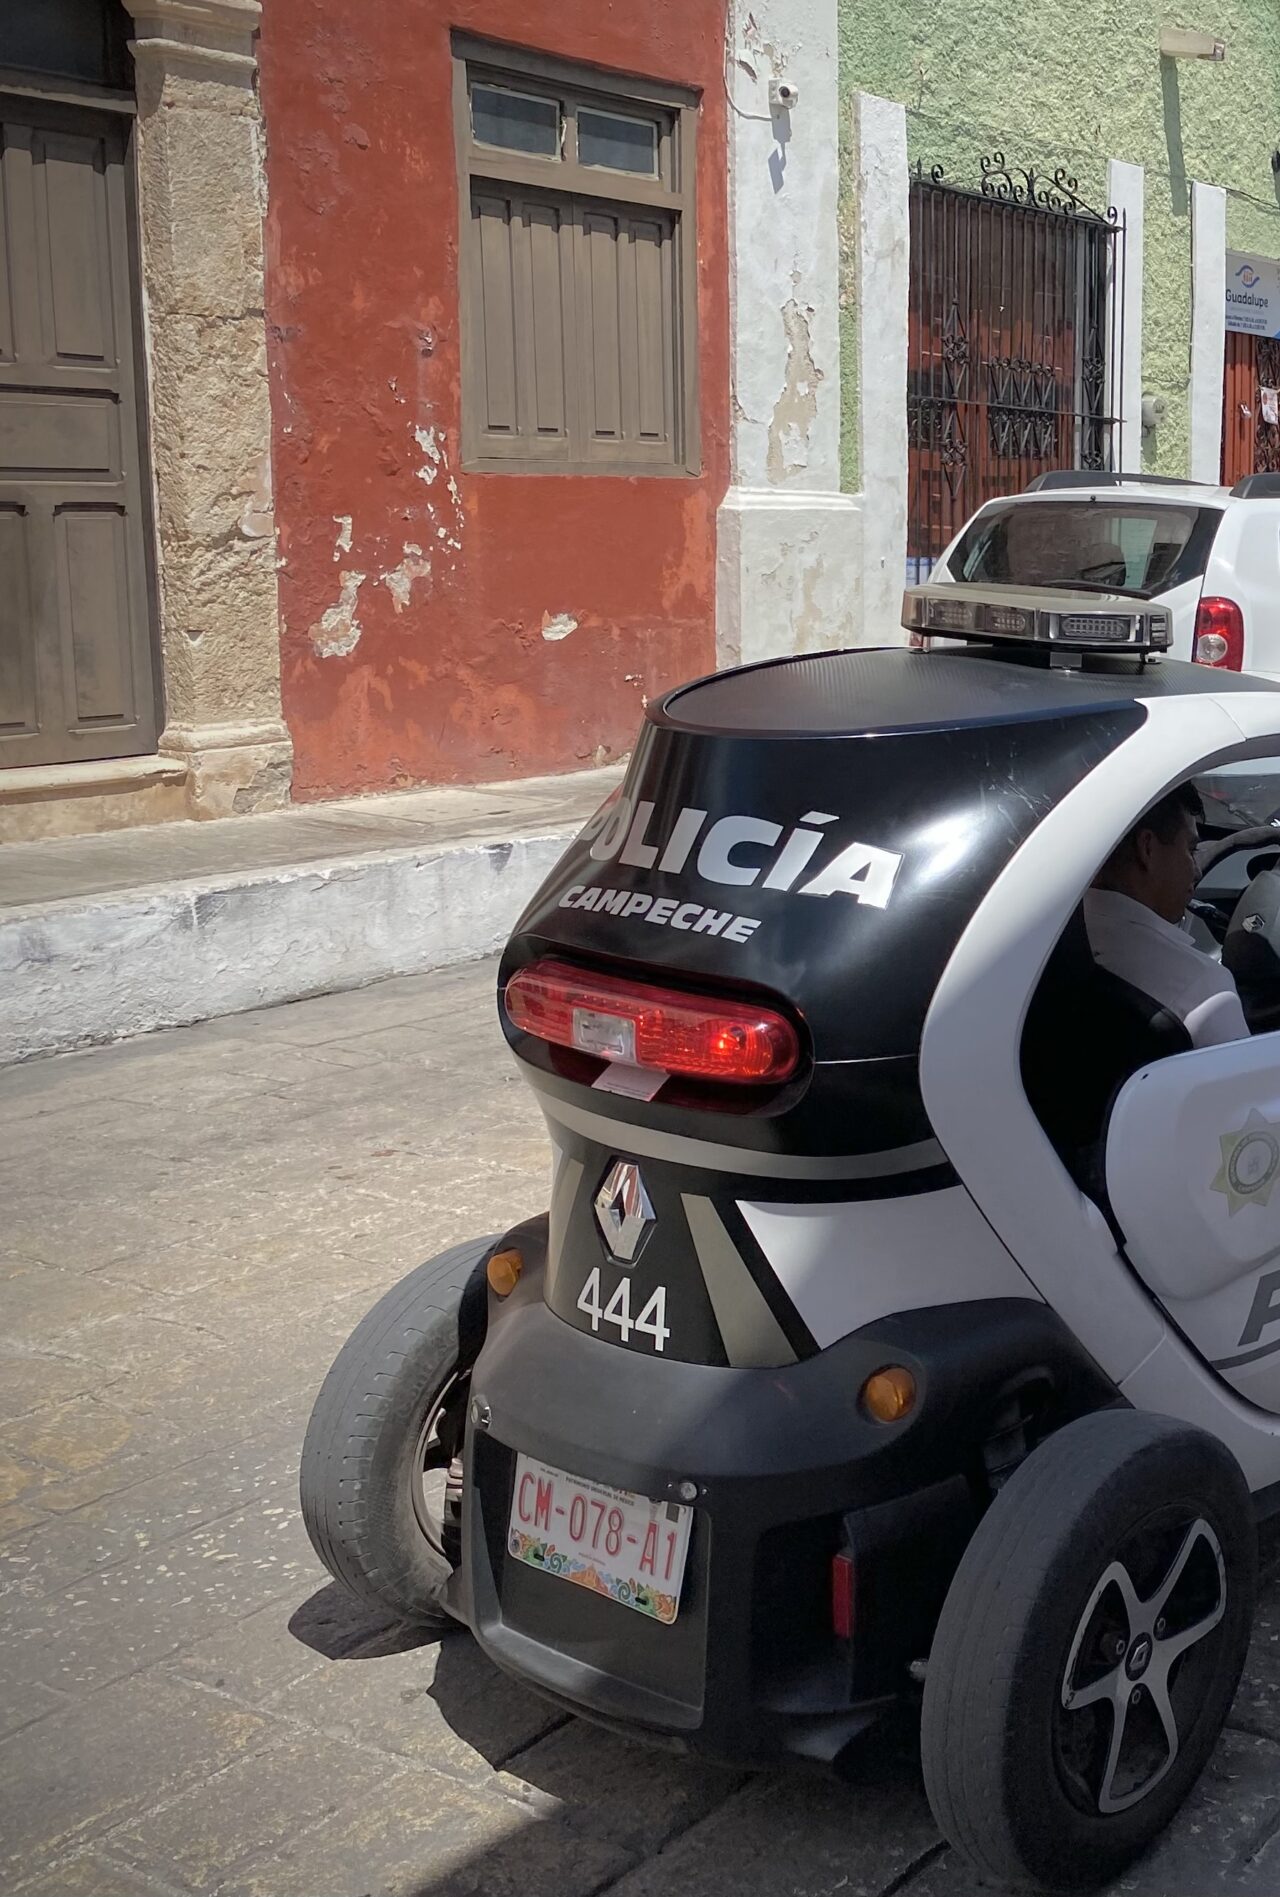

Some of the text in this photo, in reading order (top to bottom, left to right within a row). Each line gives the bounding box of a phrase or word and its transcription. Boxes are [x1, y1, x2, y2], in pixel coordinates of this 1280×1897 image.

[1226, 289, 1269, 309] Guadalupe
[558, 885, 762, 945] CAMPECHE
[577, 1267, 670, 1352] 444
[518, 1471, 678, 1581] CM-078-A1
